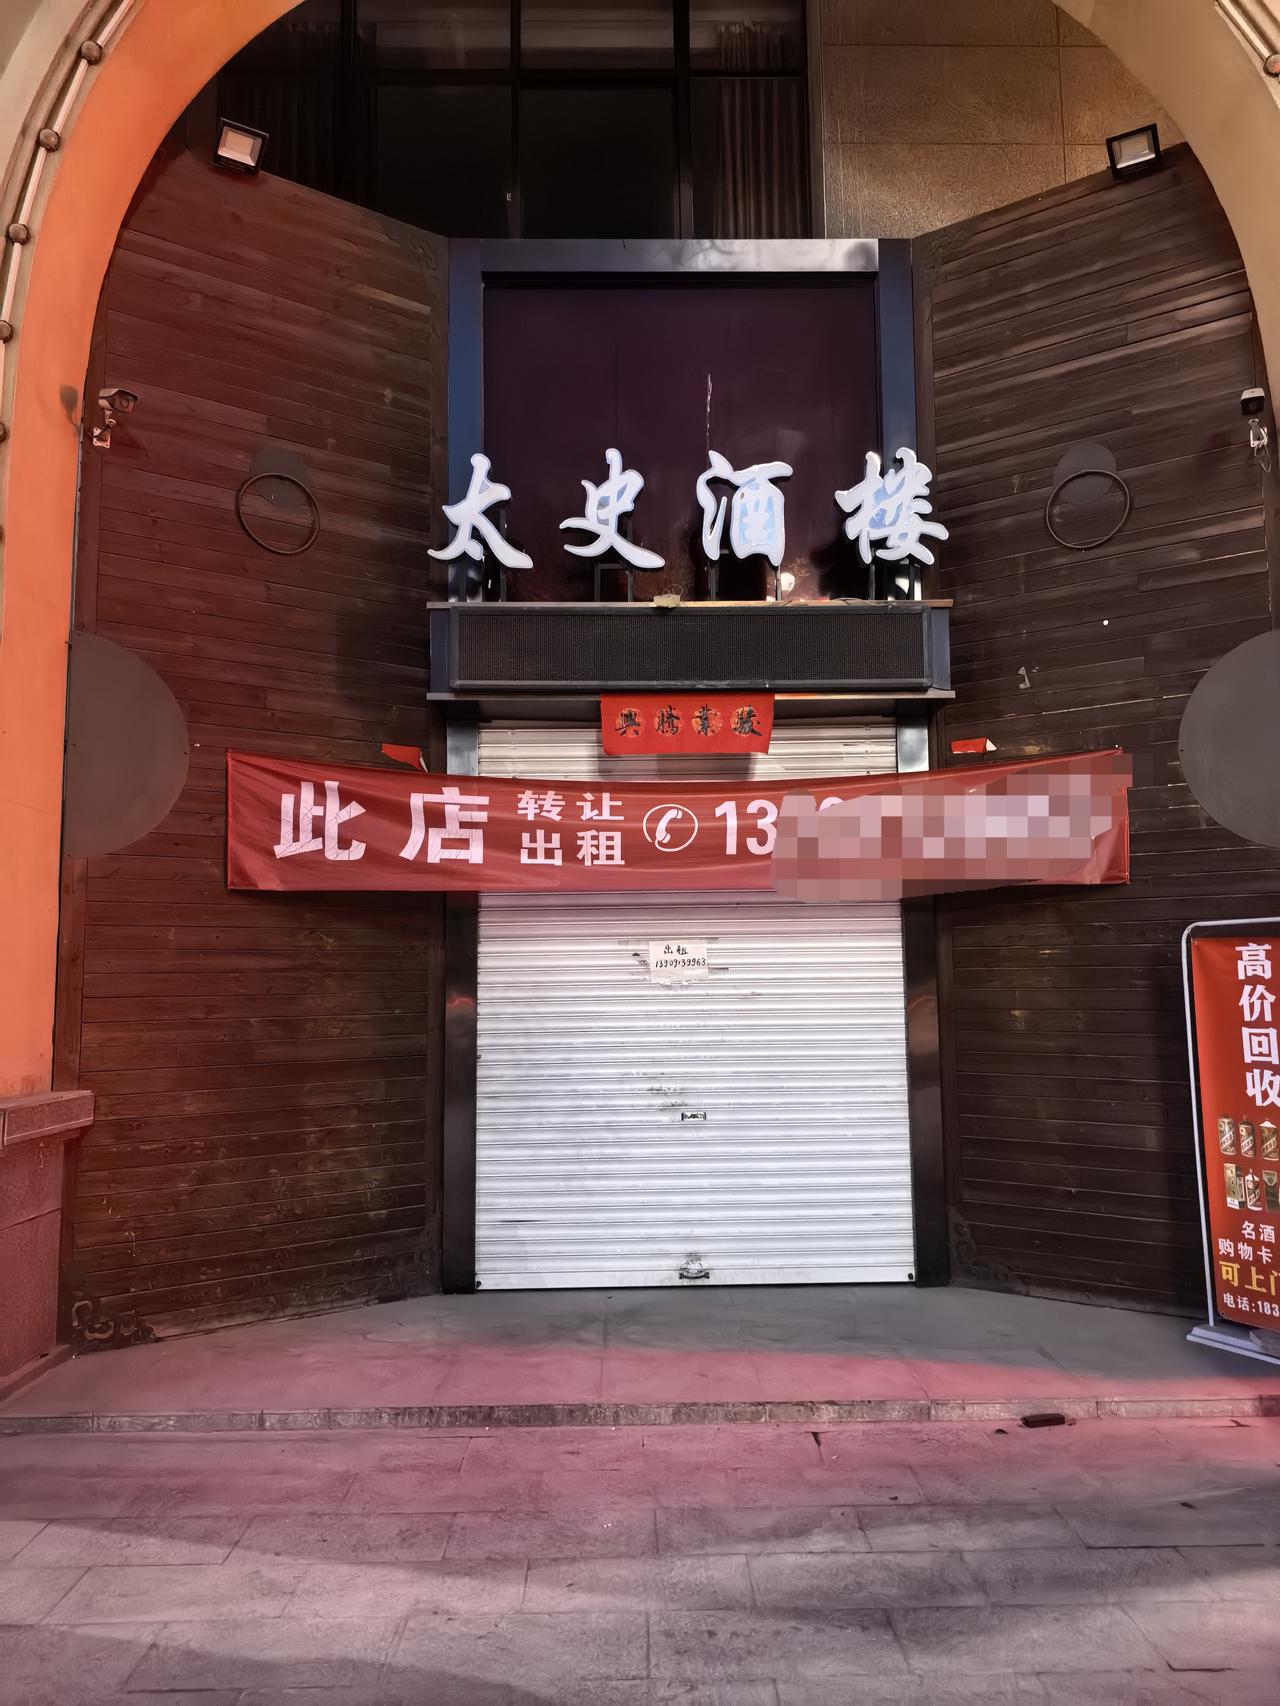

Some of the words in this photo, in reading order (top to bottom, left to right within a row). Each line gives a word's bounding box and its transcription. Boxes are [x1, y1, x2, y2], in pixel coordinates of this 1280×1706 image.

[427, 446, 950, 570] 太史酒楼
[274, 780, 490, 865] 此店
[517, 790, 625, 822] 转让
[519, 829, 625, 867] 出租
[663, 944, 688, 955] 出租
[1235, 943, 1280, 1107] 高价回收
[1241, 1220, 1276, 1243] 名酒
[1218, 1238, 1273, 1265] 购物卡
